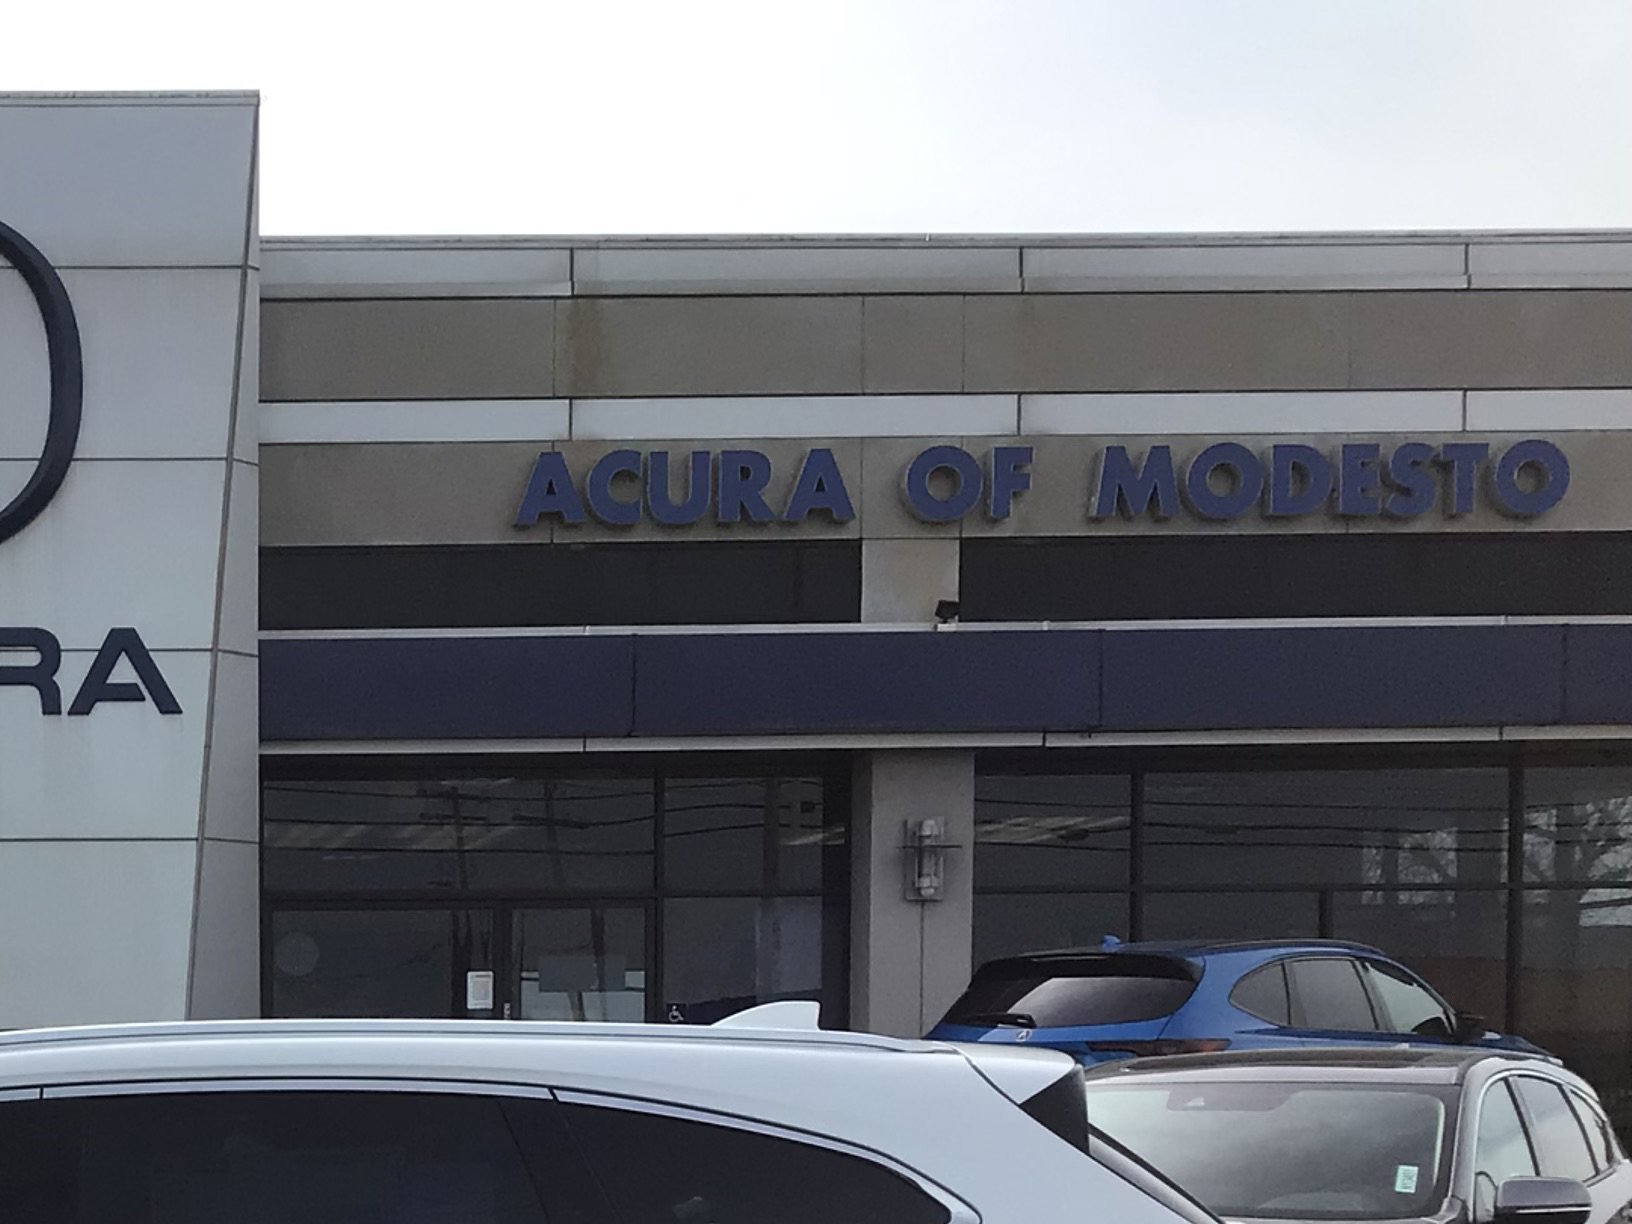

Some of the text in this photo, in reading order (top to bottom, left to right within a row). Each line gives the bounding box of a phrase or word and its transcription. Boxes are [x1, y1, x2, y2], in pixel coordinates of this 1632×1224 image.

[513, 439, 1570, 526] ACURA OF MODESTO
